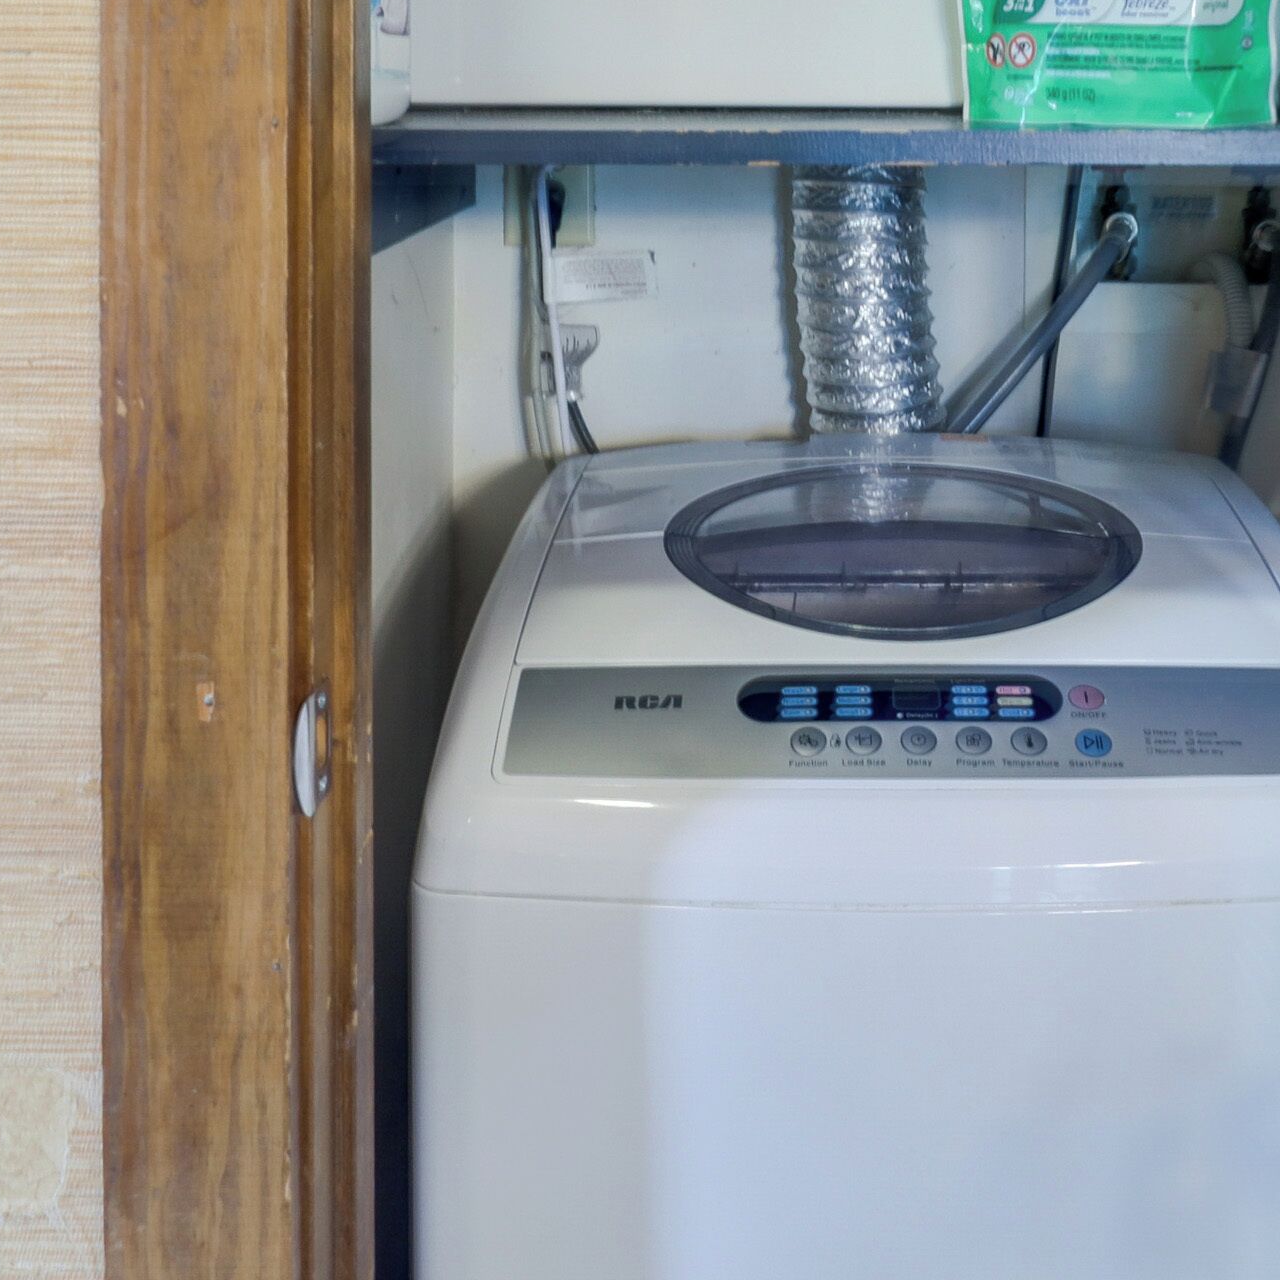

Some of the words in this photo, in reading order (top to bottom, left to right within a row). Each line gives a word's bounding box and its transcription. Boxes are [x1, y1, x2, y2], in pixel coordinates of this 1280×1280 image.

[613, 694, 684, 711] RCA
[1070, 711, 1108, 719] ON/OFF
[788, 759, 829, 768] Function
[841, 758, 864, 768] Load
[906, 758, 933, 769] Delay
[955, 759, 996, 769] Program
[1001, 759, 1061, 769] Temperature
[1068, 760, 1125, 769] Start/Pause
